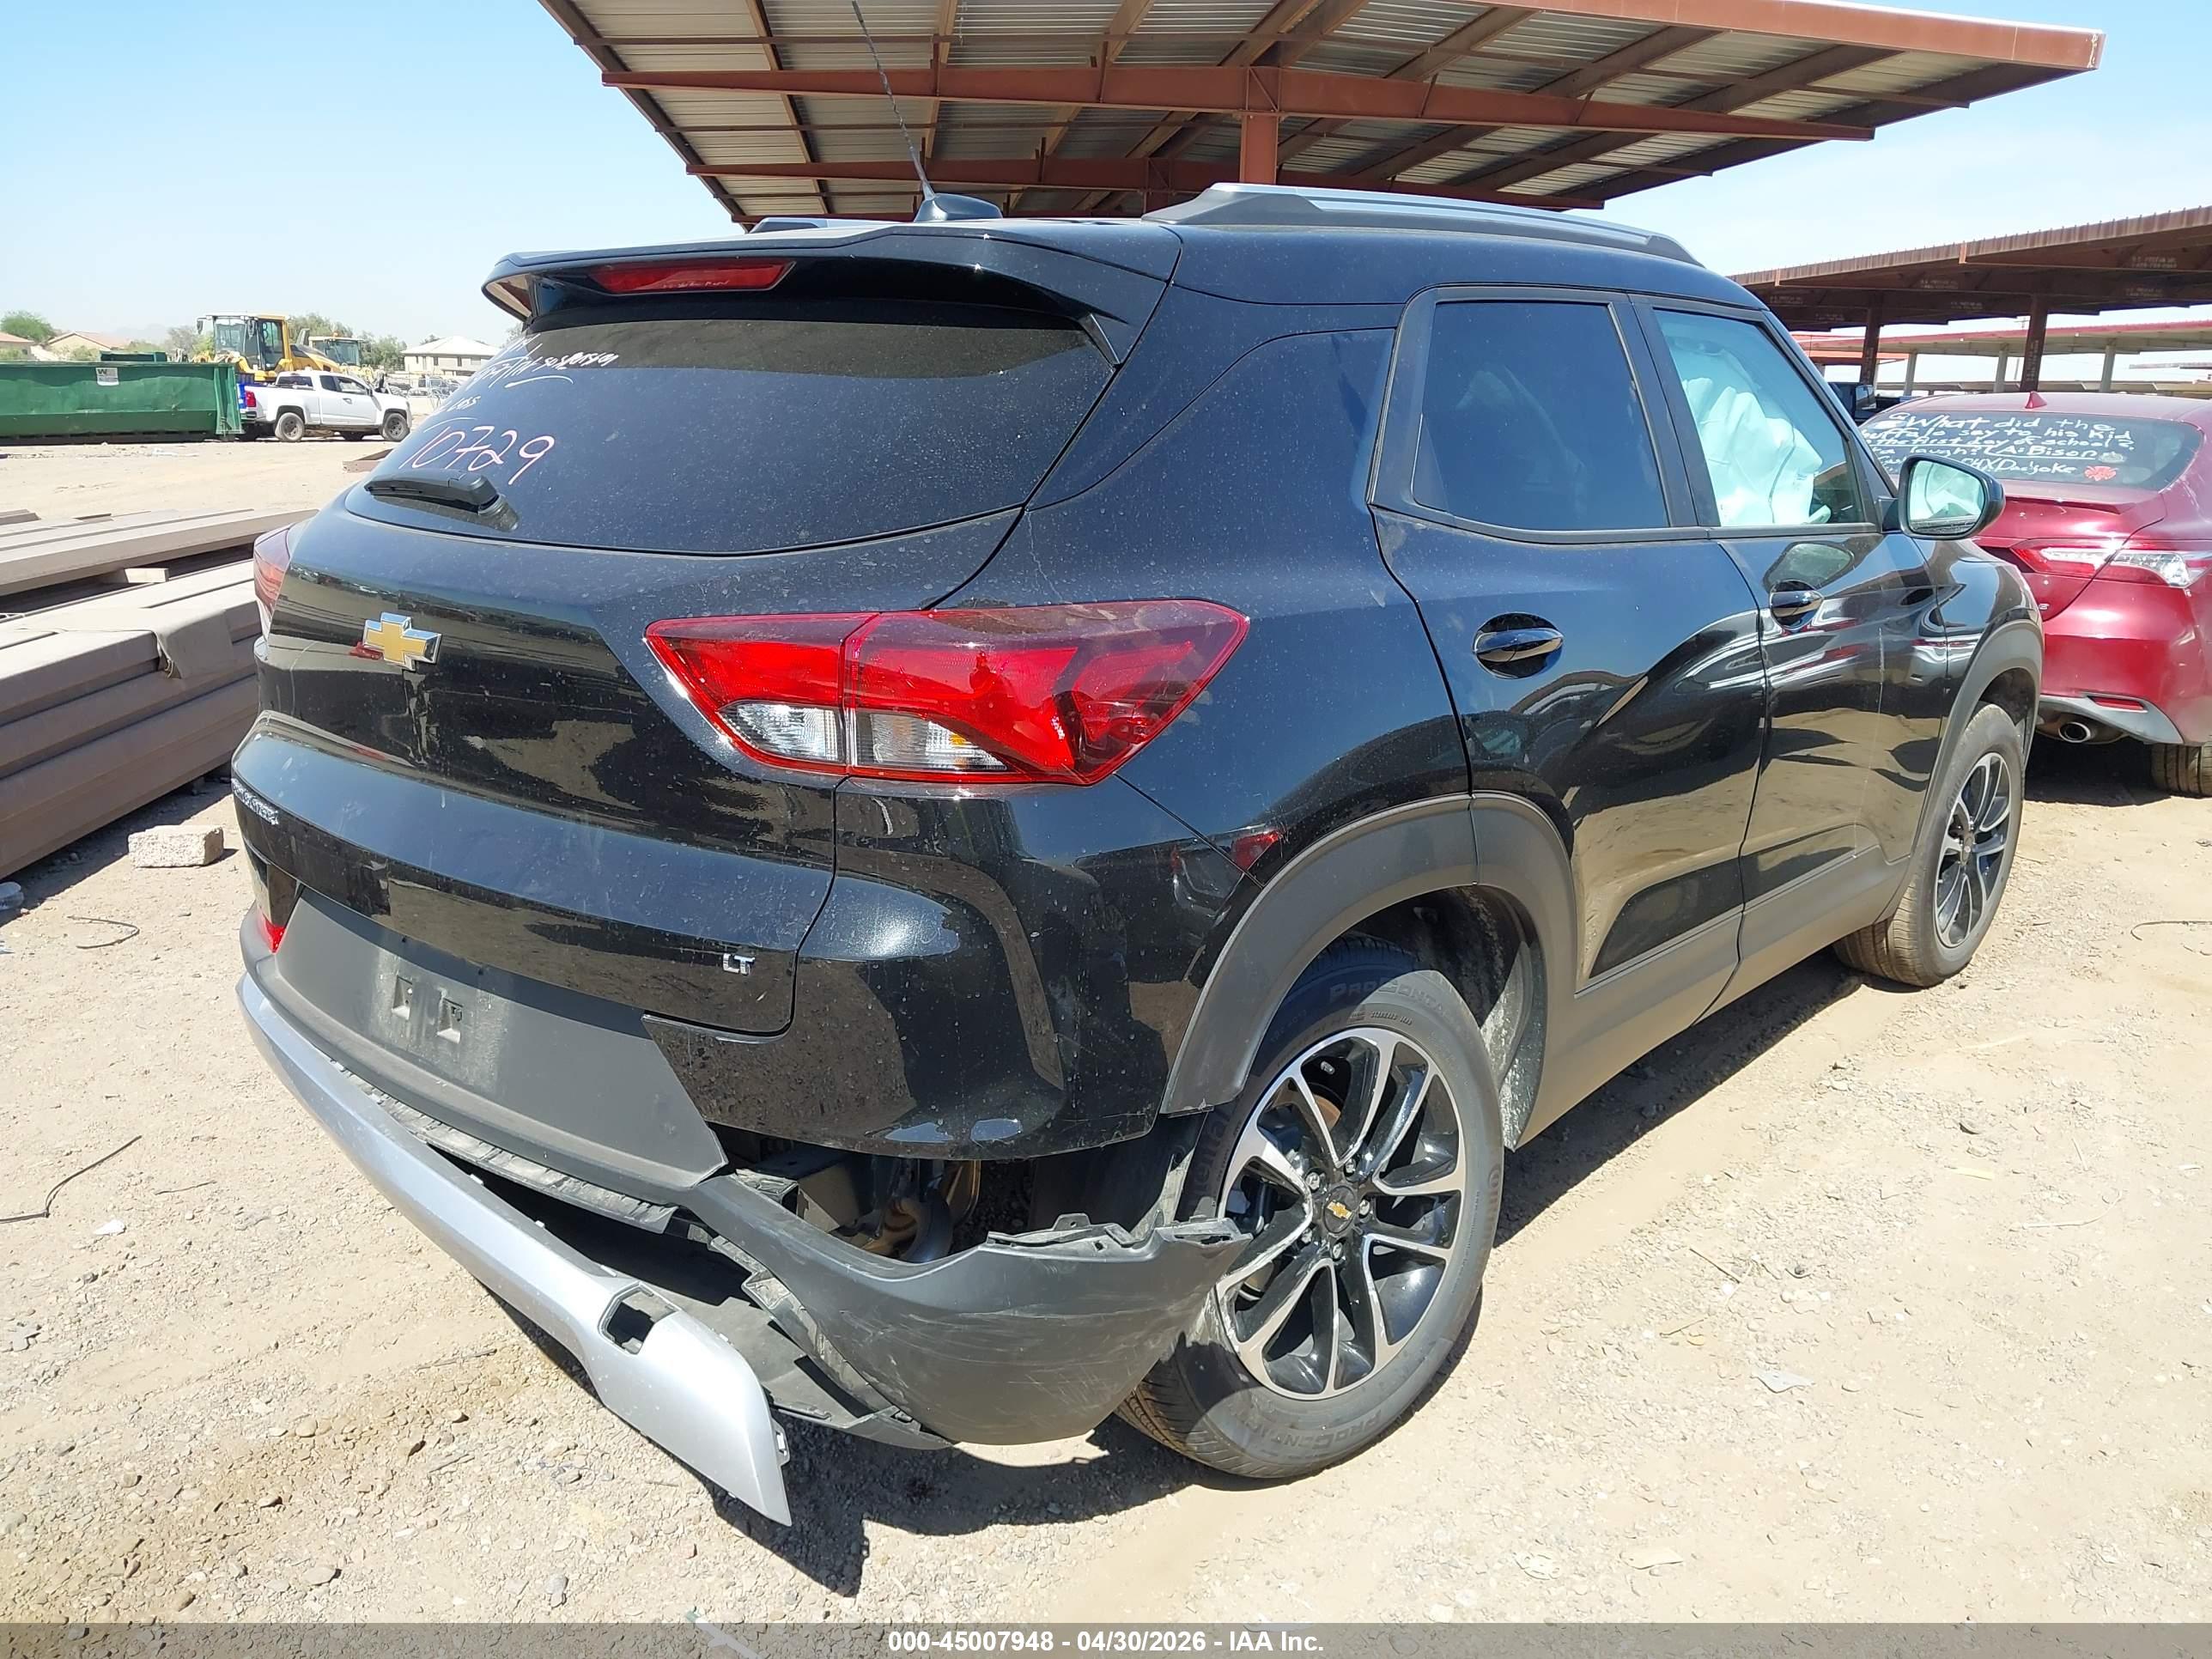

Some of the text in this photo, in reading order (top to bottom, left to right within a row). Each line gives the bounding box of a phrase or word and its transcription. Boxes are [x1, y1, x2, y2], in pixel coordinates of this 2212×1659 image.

[1907, 415, 1990, 430] What
[1994, 416, 2041, 428] did
[2056, 419, 2117, 432] the
[1862, 427, 1946, 440] buffalo
[1959, 429, 2000, 441] say
[2045, 428, 2079, 437] his
[1911, 436, 1963, 445] first
[1966, 437, 2010, 447] day
[2014, 435, 2042, 445] of
[2041, 437, 2136, 451] school?
[398, 425, 556, 486] 10729
[2027, 445, 2098, 458] Bison
[723, 952, 756, 975] LT
